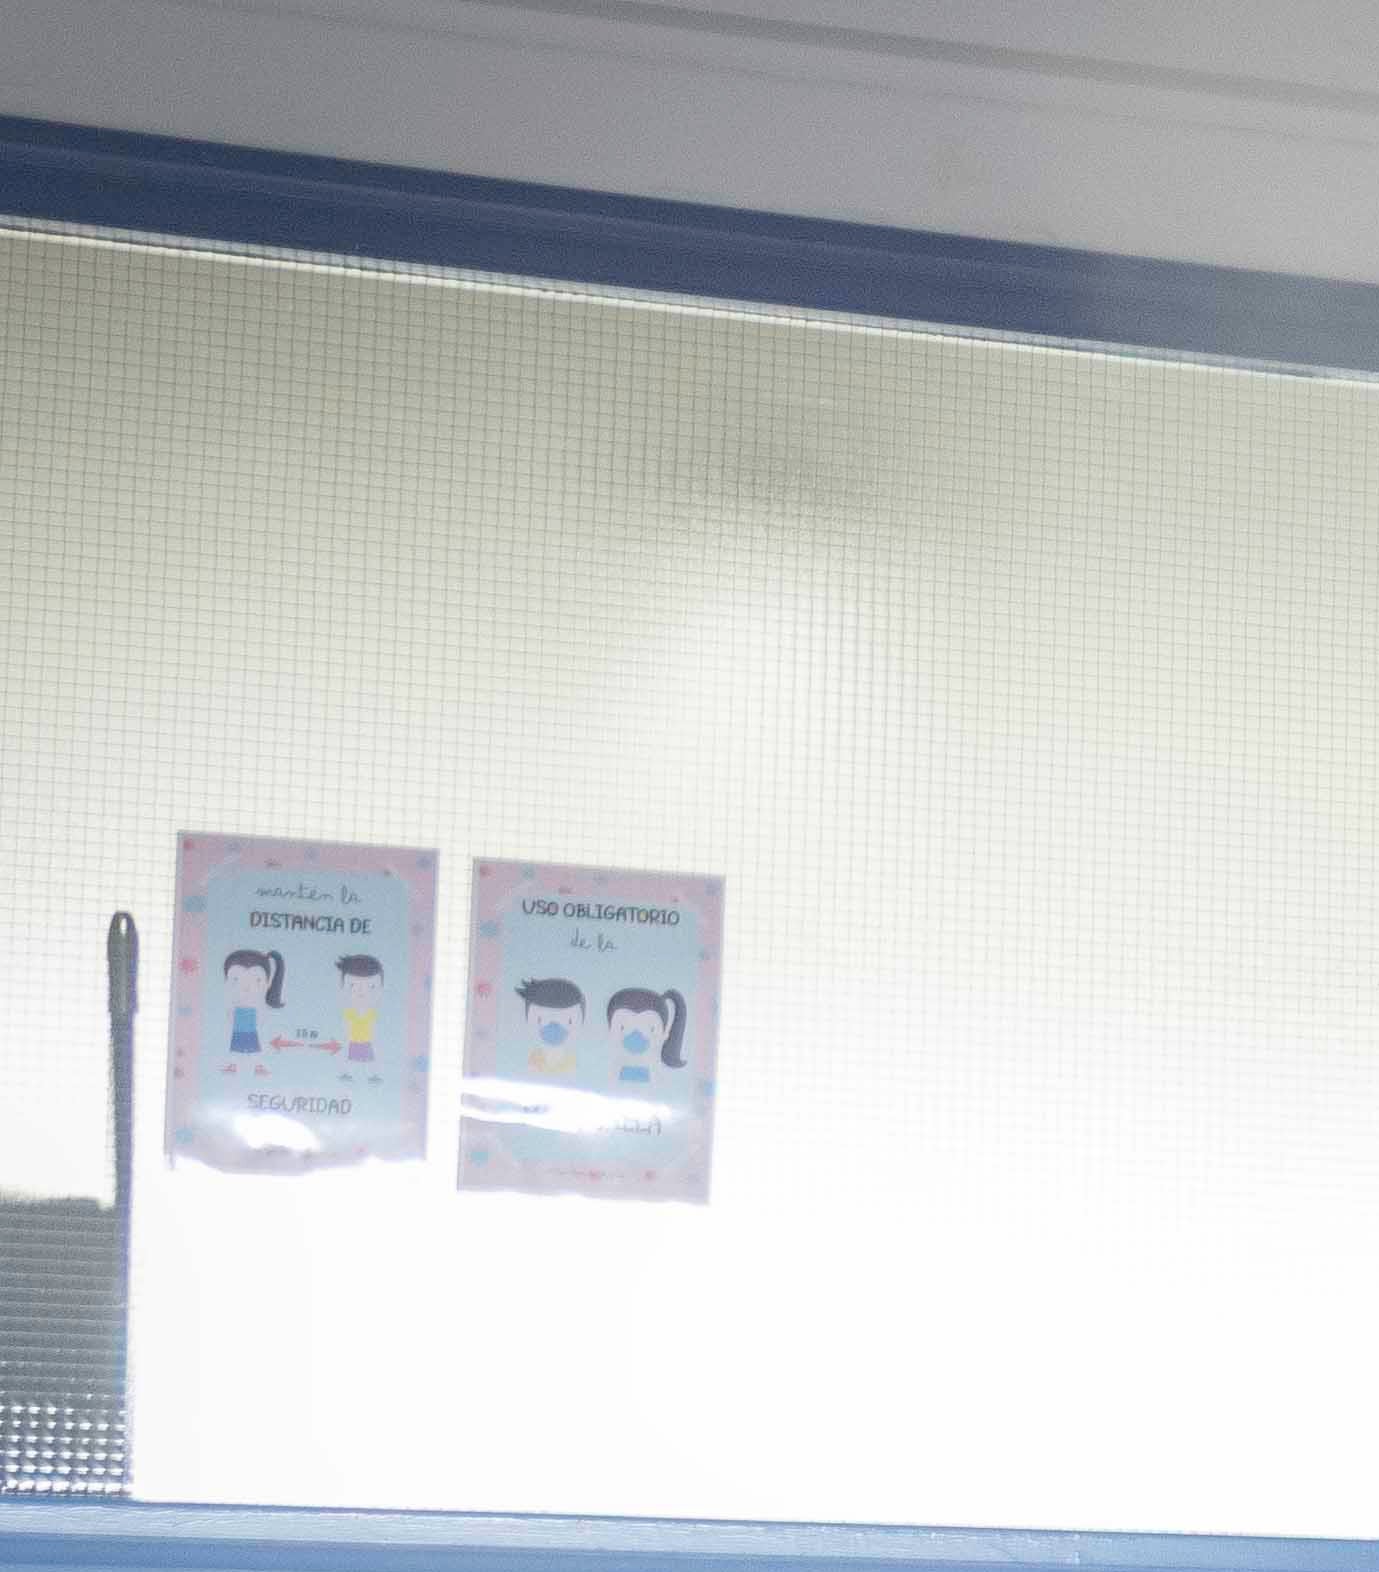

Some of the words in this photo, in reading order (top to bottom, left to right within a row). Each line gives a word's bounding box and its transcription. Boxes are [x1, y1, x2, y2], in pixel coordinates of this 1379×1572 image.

[249, 910, 346, 934] DISTANCIA
[350, 917, 373, 935] DE
[522, 899, 560, 917] USO
[562, 902, 681, 926] OBLIGATORIO
[570, 927, 593, 950] de
[247, 1093, 352, 1116] SEGURIDAD
